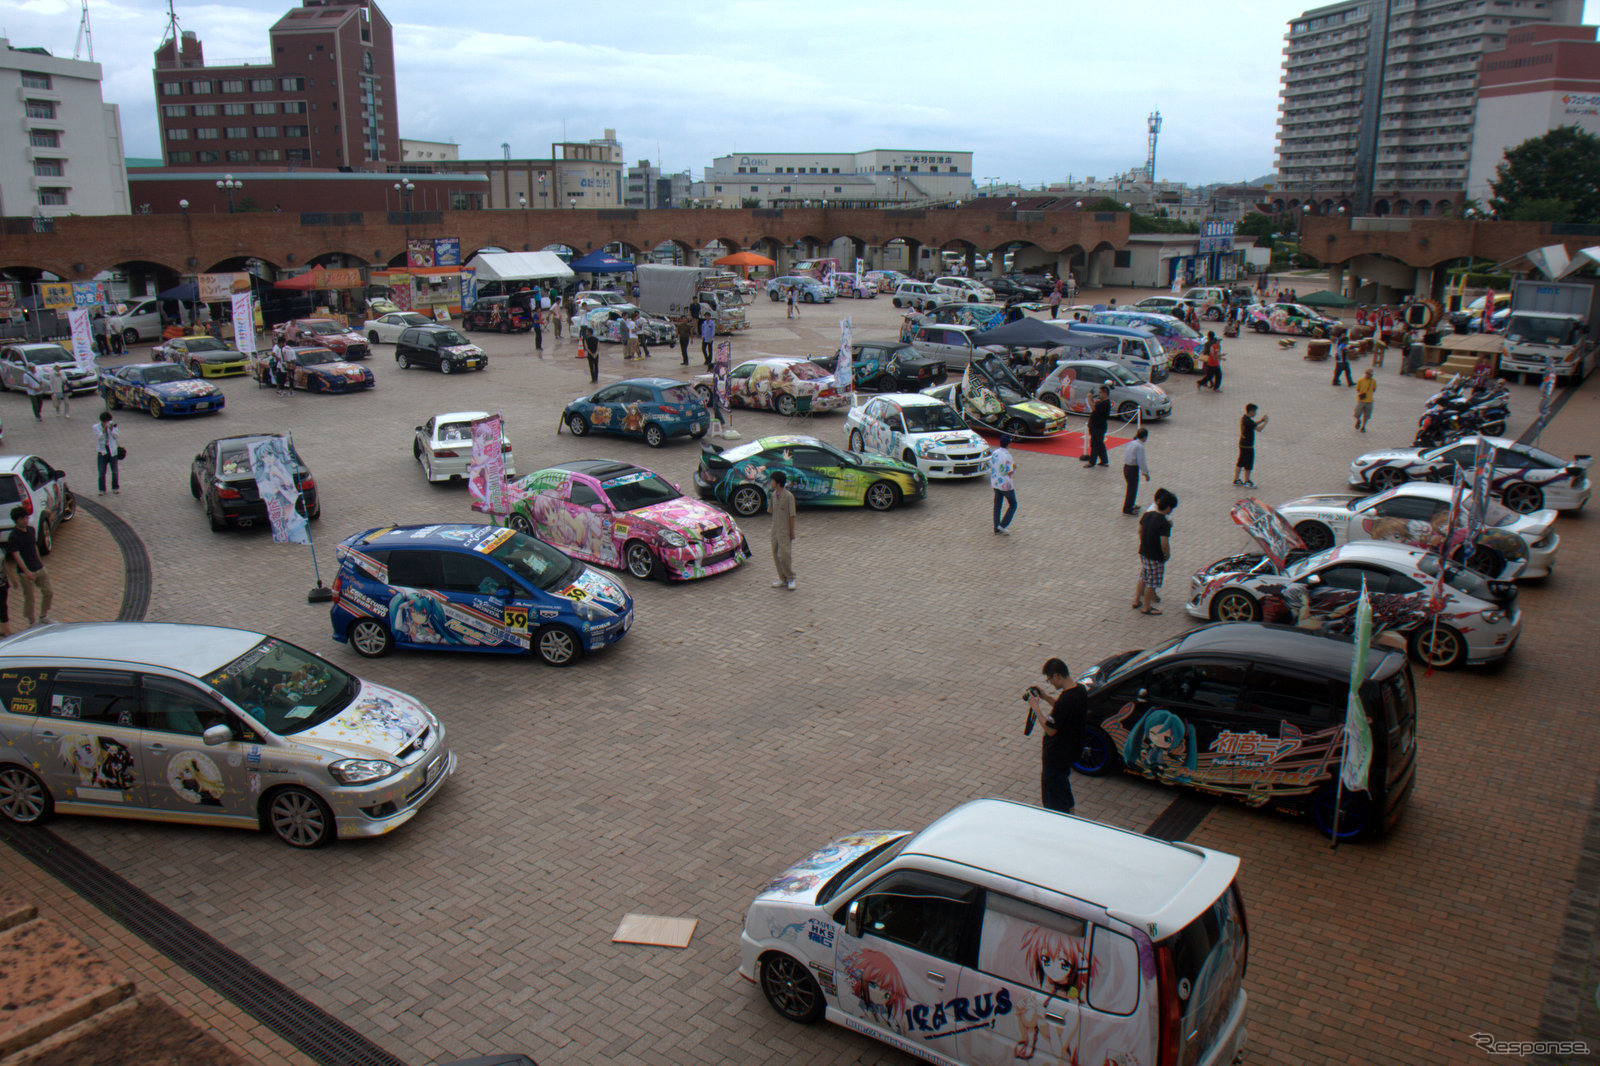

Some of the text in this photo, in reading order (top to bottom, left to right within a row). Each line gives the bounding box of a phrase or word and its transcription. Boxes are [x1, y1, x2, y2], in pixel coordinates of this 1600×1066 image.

[566, 588, 587, 601] 39
[505, 612, 527, 628] 39
[12, 702, 36, 712] nm7
[1212, 758, 1265, 767] Future Stars
[1238, 767, 1317, 785] mirai
[811, 924, 835, 940] HKS
